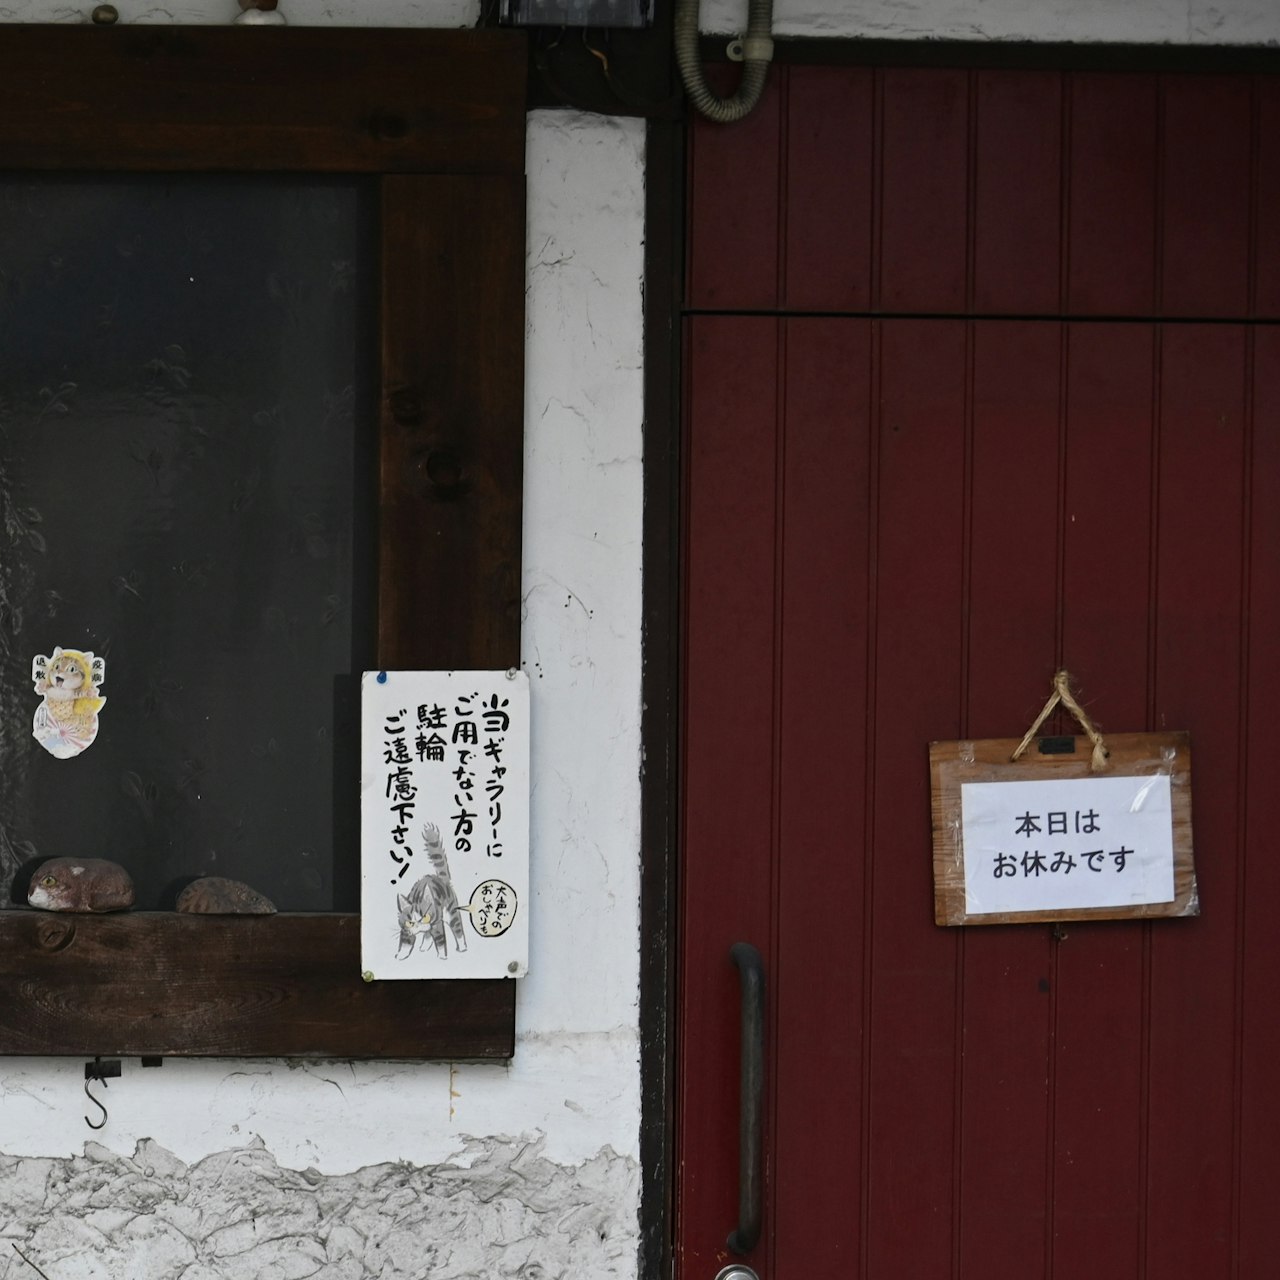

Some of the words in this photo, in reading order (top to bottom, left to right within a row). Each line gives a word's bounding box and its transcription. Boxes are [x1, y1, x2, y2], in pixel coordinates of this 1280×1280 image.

[414, 703, 448, 763] 駐輪
[450, 692, 479, 852] ご用でない方の
[481, 693, 511, 858] 当ギャラリーに
[1014, 808, 1101, 838] 本日は
[992, 845, 1135, 879] お休みです
